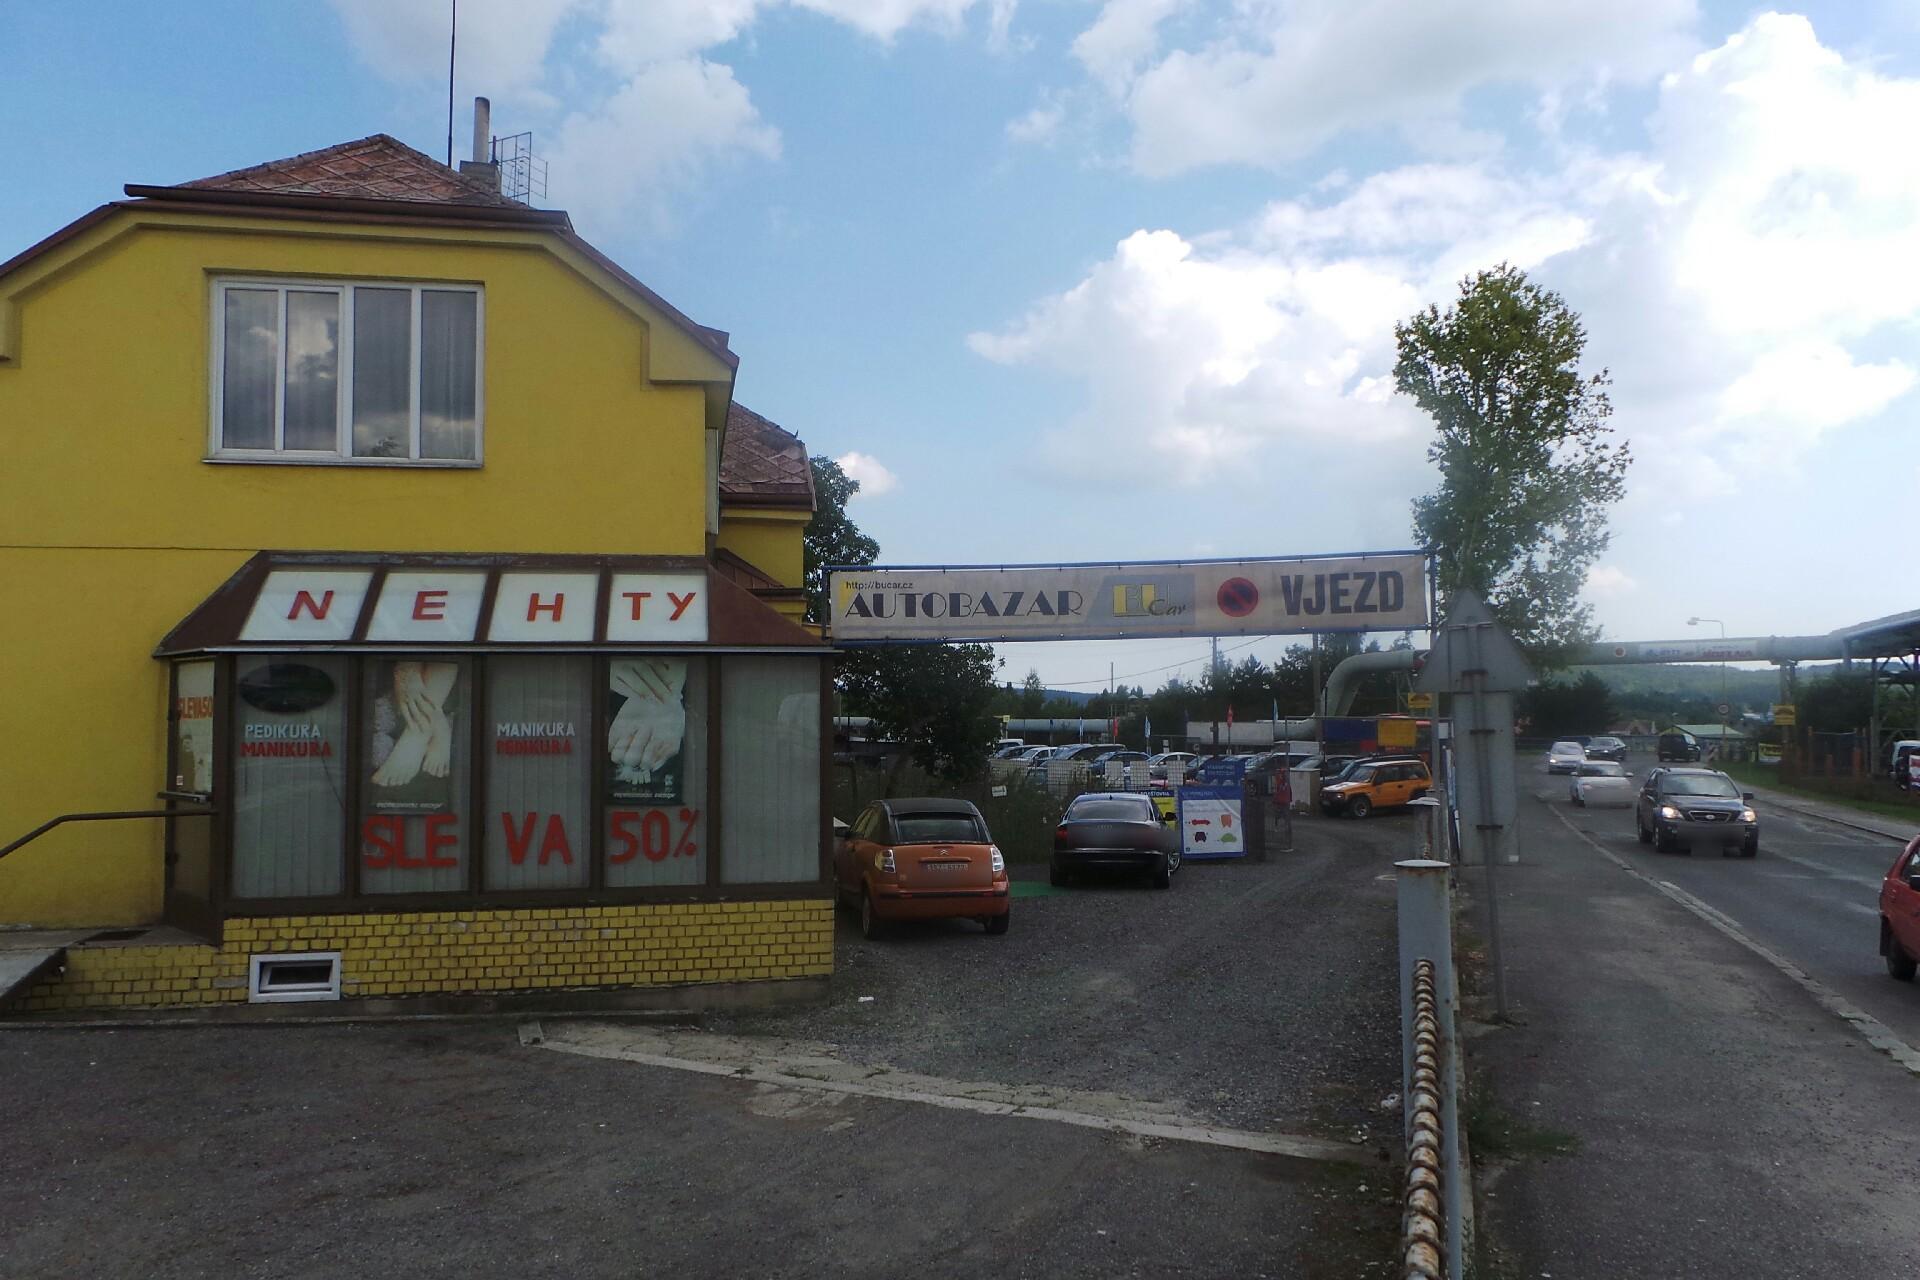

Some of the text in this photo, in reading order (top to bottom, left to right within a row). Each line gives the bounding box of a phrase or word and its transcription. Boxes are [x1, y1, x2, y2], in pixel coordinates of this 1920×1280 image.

[846, 581, 914, 590] http://bucar.cz
[1280, 570, 1405, 617] VJEZD
[844, 590, 1084, 619] AUTOBAZAR
[244, 723, 321, 739] PEDIKURA
[496, 722, 576, 737] MANIKURA
[609, 807, 700, 865] 50%
